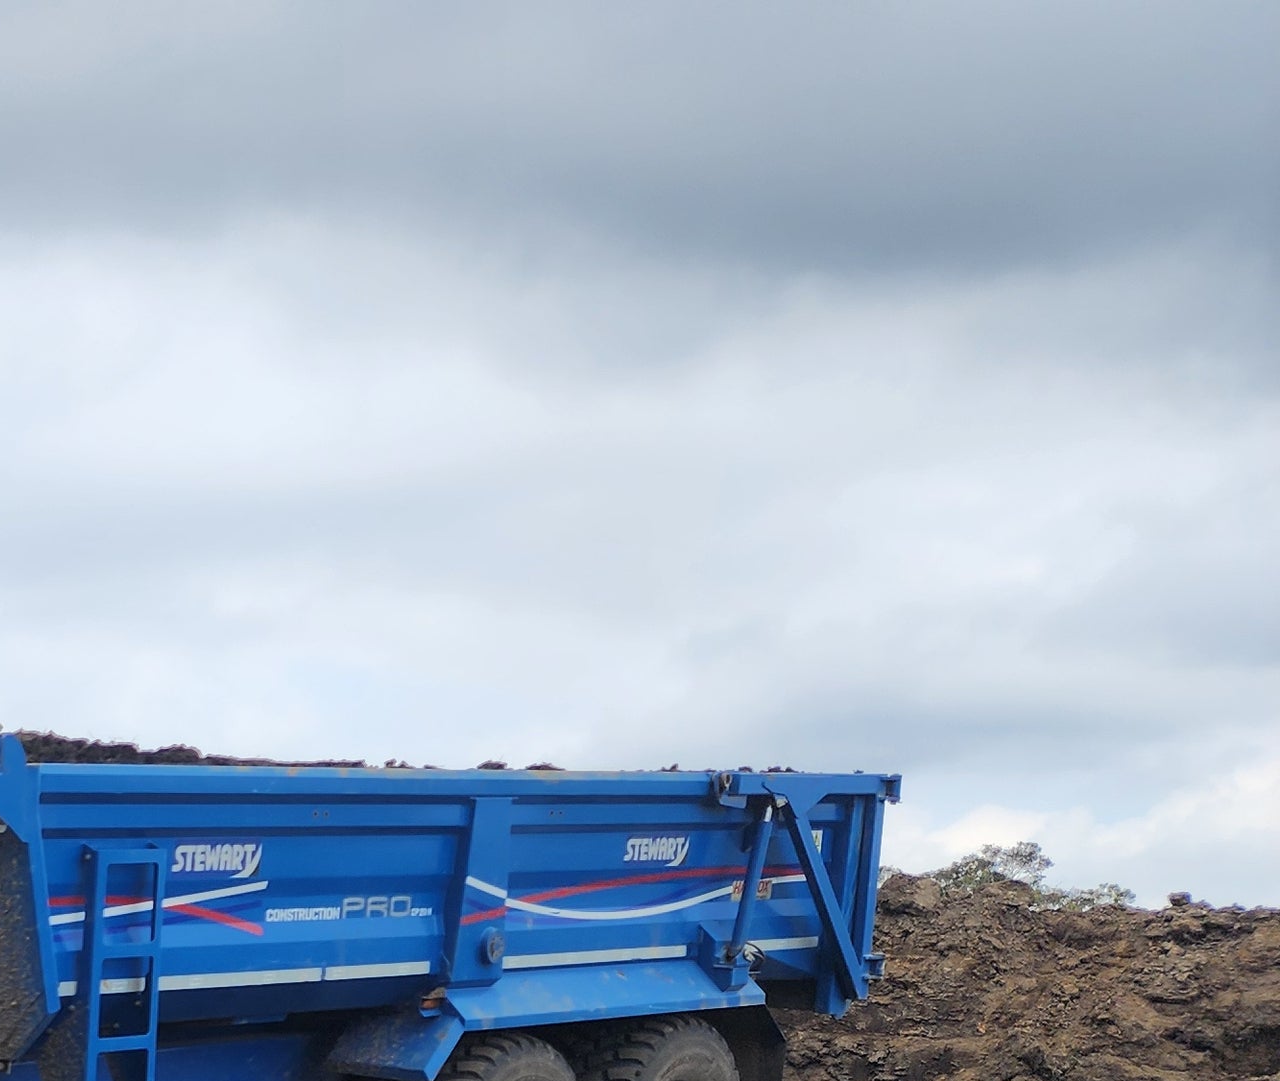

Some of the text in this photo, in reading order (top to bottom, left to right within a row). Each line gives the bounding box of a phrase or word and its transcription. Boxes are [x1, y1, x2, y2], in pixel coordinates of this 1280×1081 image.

[171, 843, 263, 878] STEWART
[623, 836, 689, 867] STEWART
[265, 906, 340, 923] CONSTRUCTION
[342, 895, 412, 918] PRO
